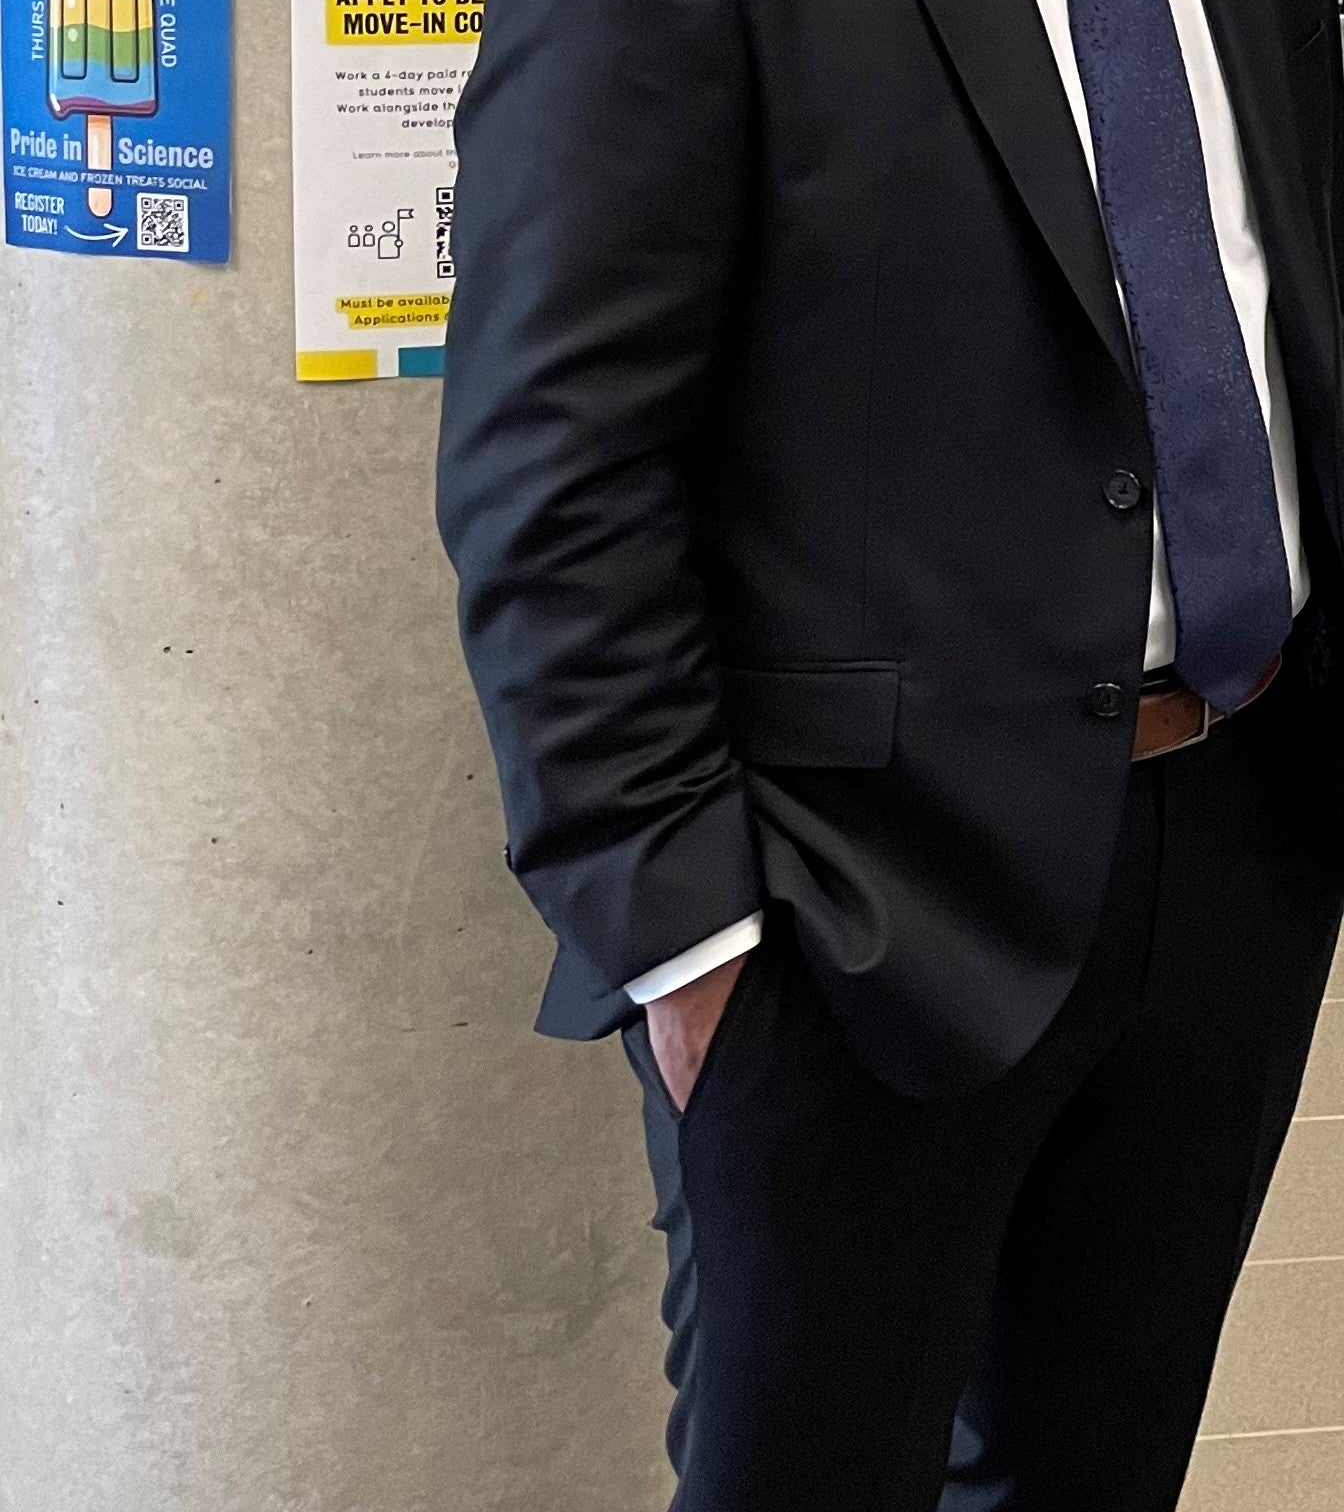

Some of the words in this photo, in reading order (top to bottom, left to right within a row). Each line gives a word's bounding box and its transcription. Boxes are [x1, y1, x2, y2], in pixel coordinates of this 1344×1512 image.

[31, 0, 45, 62] THURS
[344, 12, 446, 35] MOVE-IN
[160, 13, 178, 68] QUAD
[335, 70, 367, 80] Work
[372, 72, 380, 80] a
[427, 69, 458, 82] paid
[358, 86, 415, 97] students
[418, 87, 454, 96] move
[336, 103, 370, 114] Work
[373, 102, 439, 115] alongside
[10, 128, 58, 160] Pride
[63, 134, 82, 162] in
[118, 137, 214, 169] Science
[12, 165, 26, 177] ICE
[28, 167, 58, 180] CREAM
[59, 170, 79, 182] AND
[80, 172, 123, 186] FROZEN
[126, 174, 166, 188] TREATS
[167, 178, 208, 190] SOCIAL
[14, 191, 65, 215] REGISTER
[21, 214, 58, 236] TODAY!
[340, 298, 372, 310] Must
[376, 298, 394, 308] be
[354, 312, 440, 326] Applications
